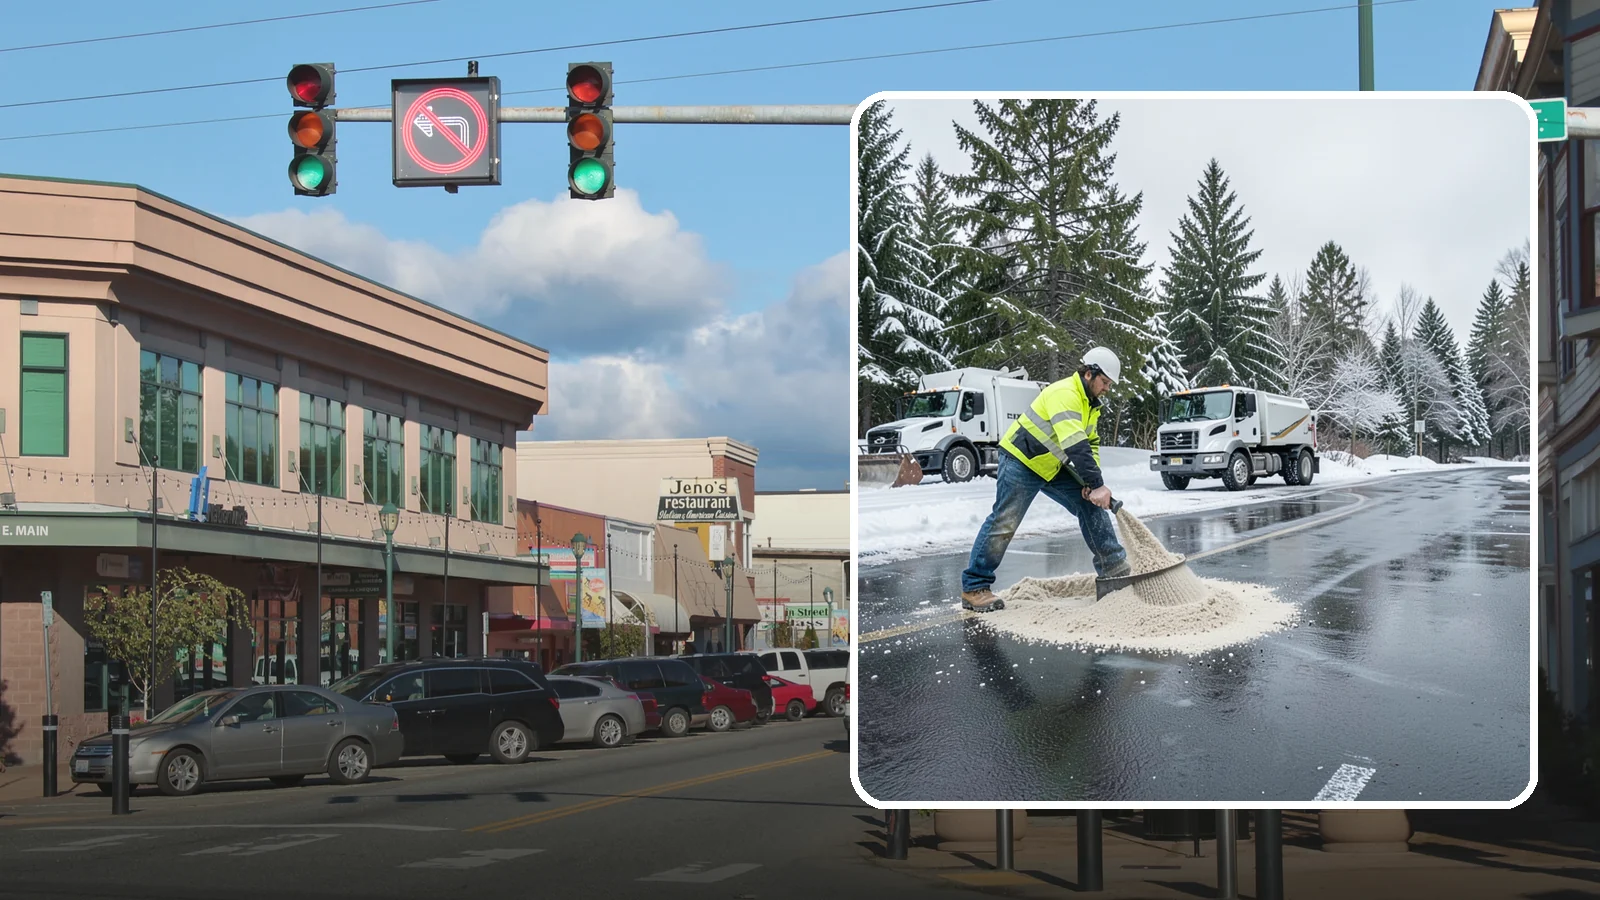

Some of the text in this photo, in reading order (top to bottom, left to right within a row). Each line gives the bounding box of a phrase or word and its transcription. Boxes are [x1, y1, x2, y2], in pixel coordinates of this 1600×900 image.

[669, 480, 728, 494] Jeno's
[665, 496, 731, 509] restaurant
[658, 510, 681, 519] Italian
[686, 510, 714, 519] American
[715, 509, 738, 519] Cuisine
[2, 525, 49, 536] E. MAIN
[797, 608, 828, 616] Street
